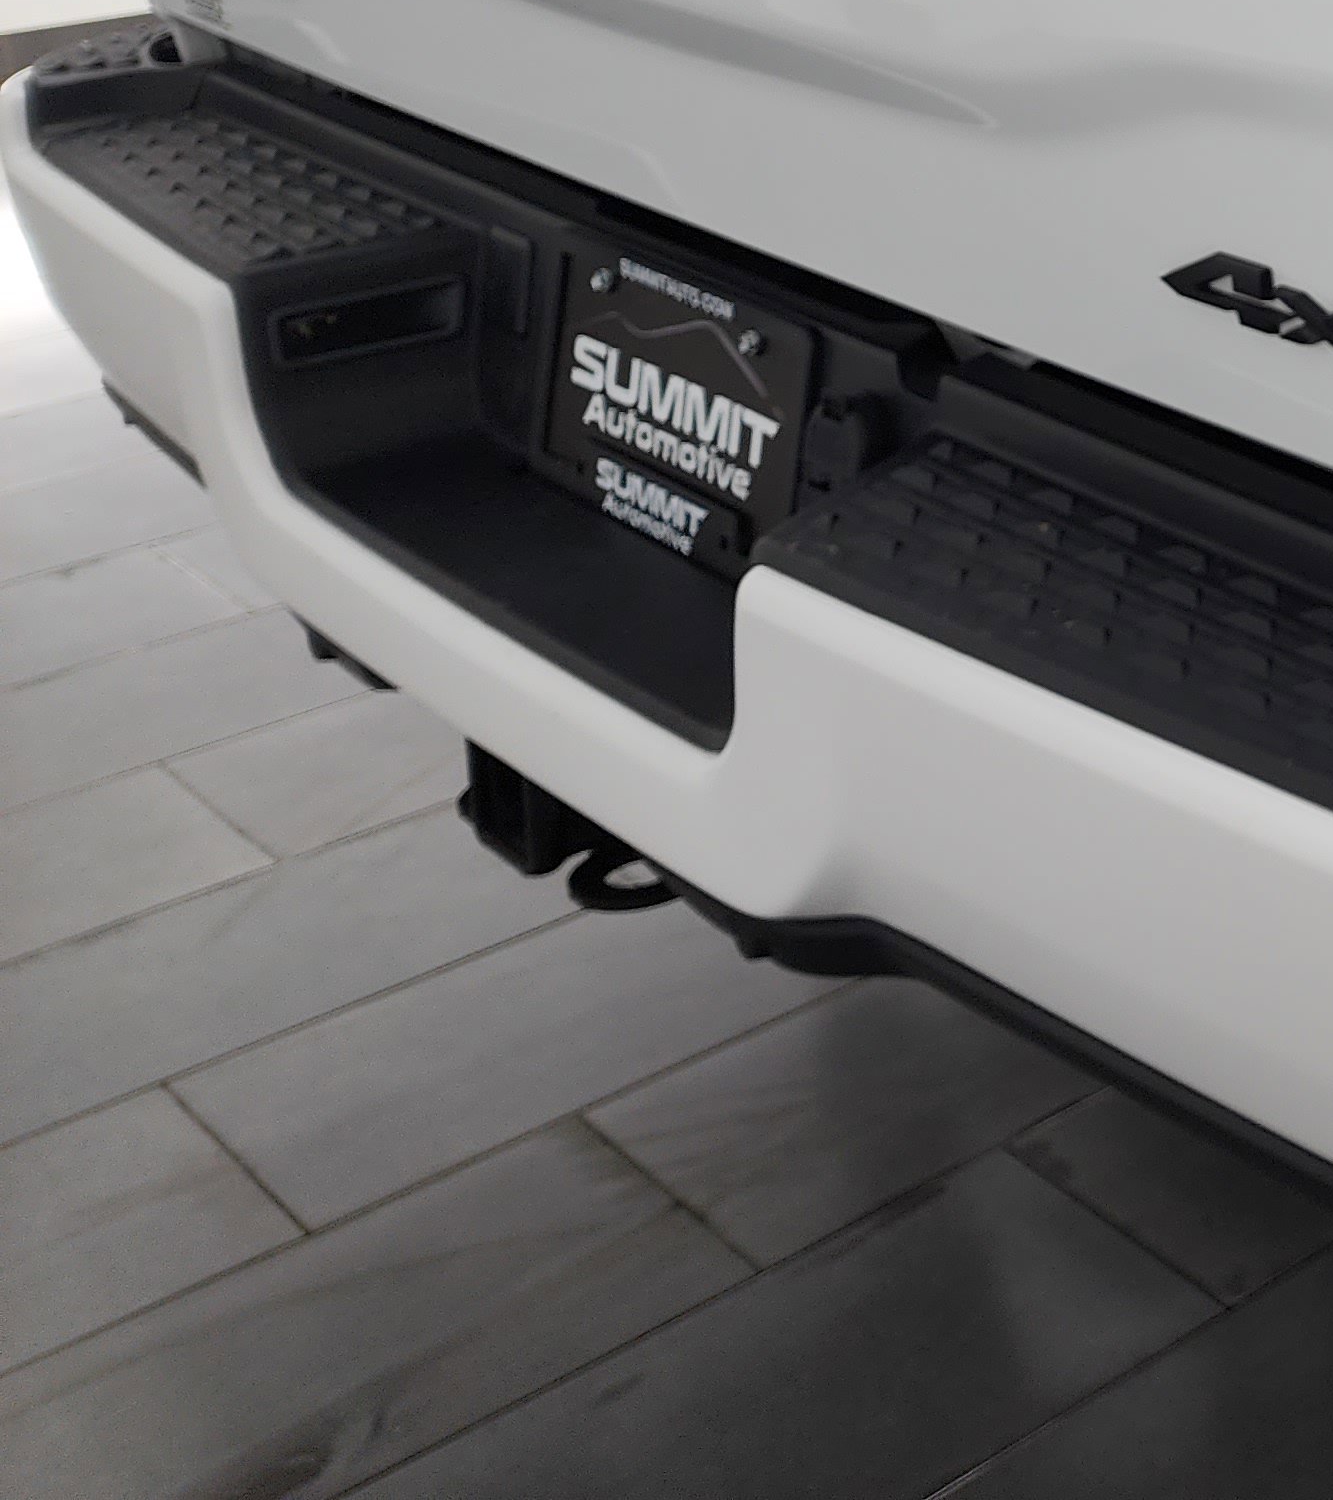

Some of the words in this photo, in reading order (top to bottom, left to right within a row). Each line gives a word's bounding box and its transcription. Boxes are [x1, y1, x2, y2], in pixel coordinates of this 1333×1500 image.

[569, 333, 781, 470] SUMMIT
[581, 392, 752, 502] Automotive
[594, 456, 711, 538] SUMMIT
[600, 492, 696, 557] Automotive
